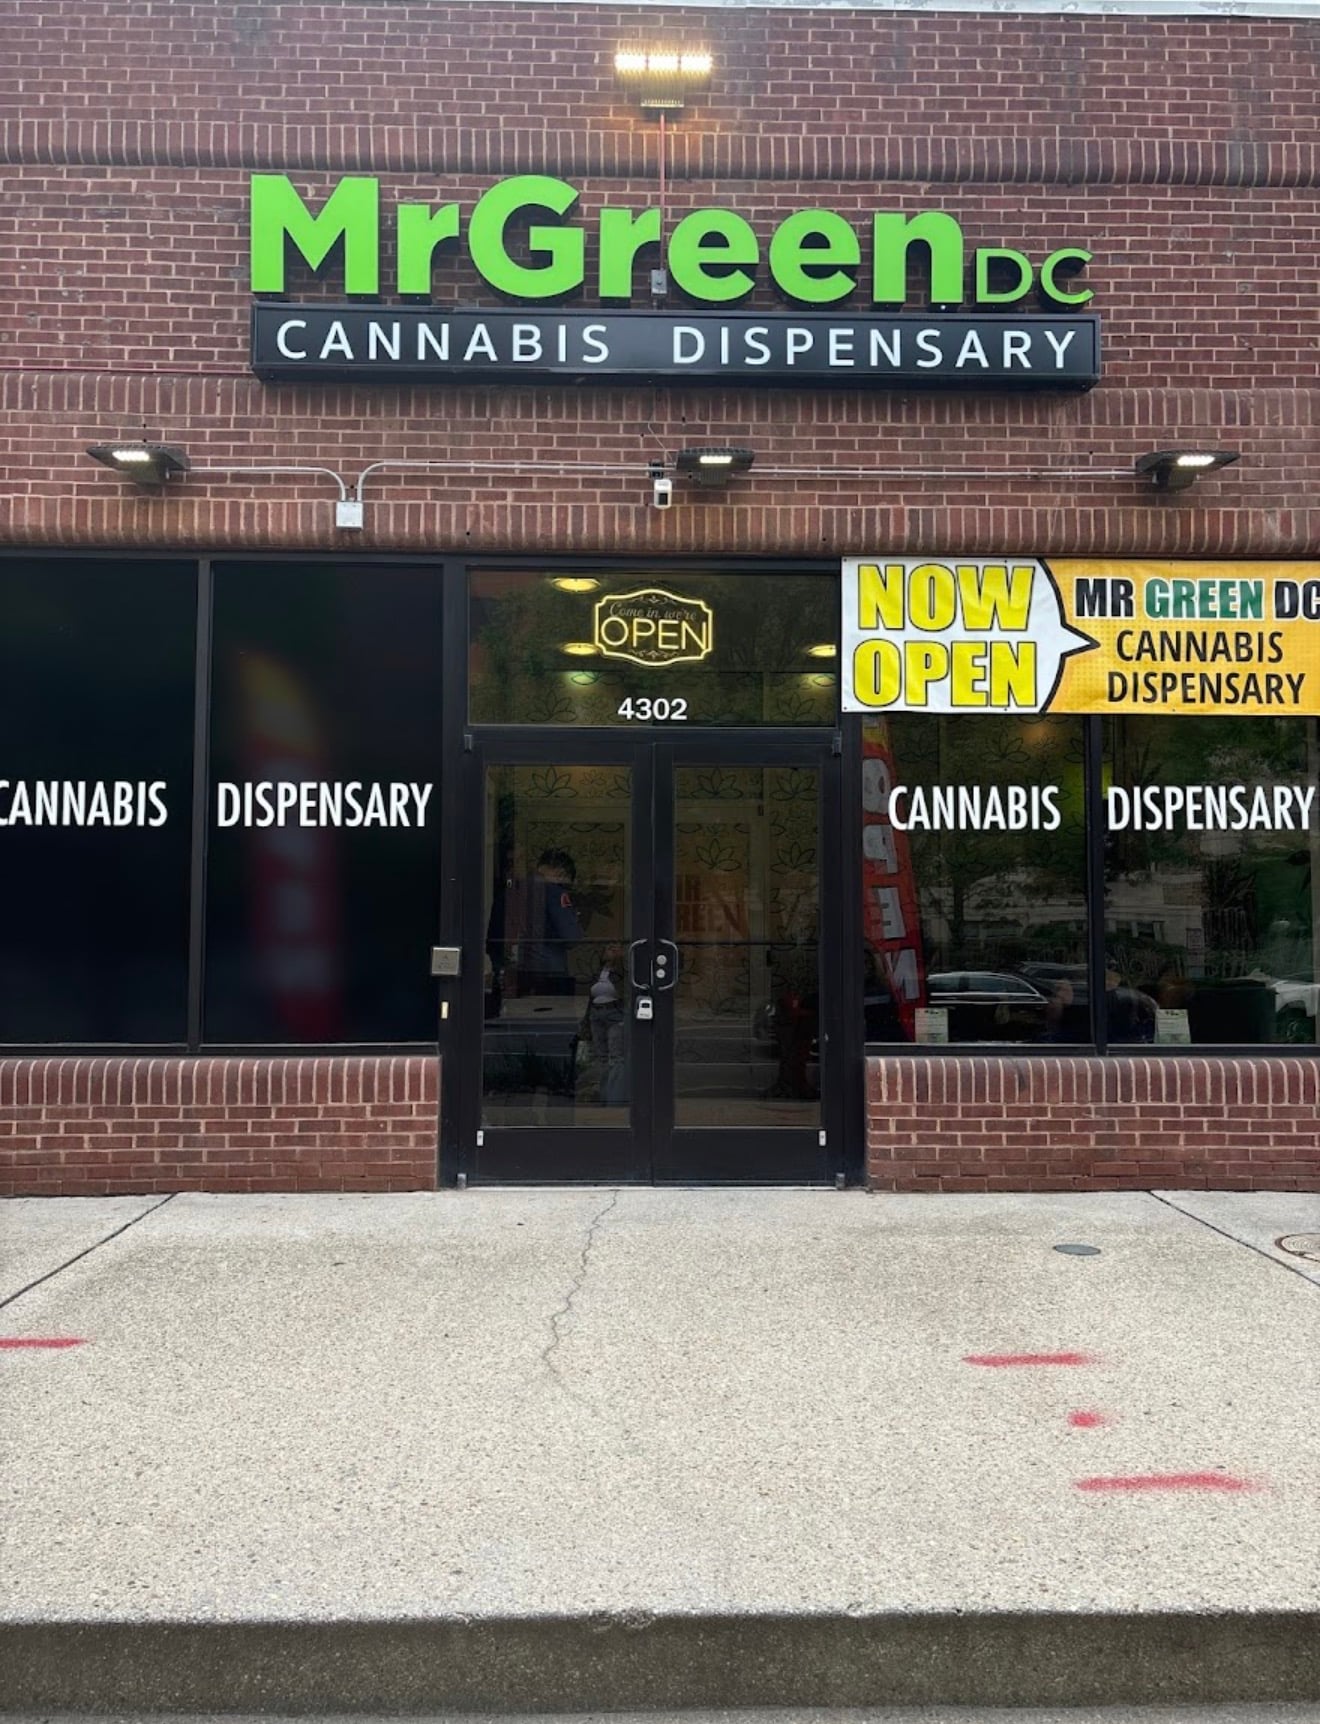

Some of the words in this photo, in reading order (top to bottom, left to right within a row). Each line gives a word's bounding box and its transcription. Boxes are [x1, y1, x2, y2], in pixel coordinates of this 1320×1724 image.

[276, 319, 610, 364] CANNABIS
[672, 325, 1076, 369] DISPENSARY
[858, 563, 1035, 631] NOW
[1075, 577, 1133, 618] MR
[1145, 578, 1264, 620] GREEN
[1274, 580, 1320, 620] DC
[601, 616, 707, 651] OPEN
[1116, 630, 1283, 664] CANNABIS
[852, 638, 1037, 708] OPEN
[1108, 671, 1306, 704] DISPENSARY
[617, 697, 688, 721] 4302
[217, 781, 433, 828] DISPENSARY
[888, 785, 1061, 831] CANNABIS
[1107, 785, 1316, 831] DISPENSARY
